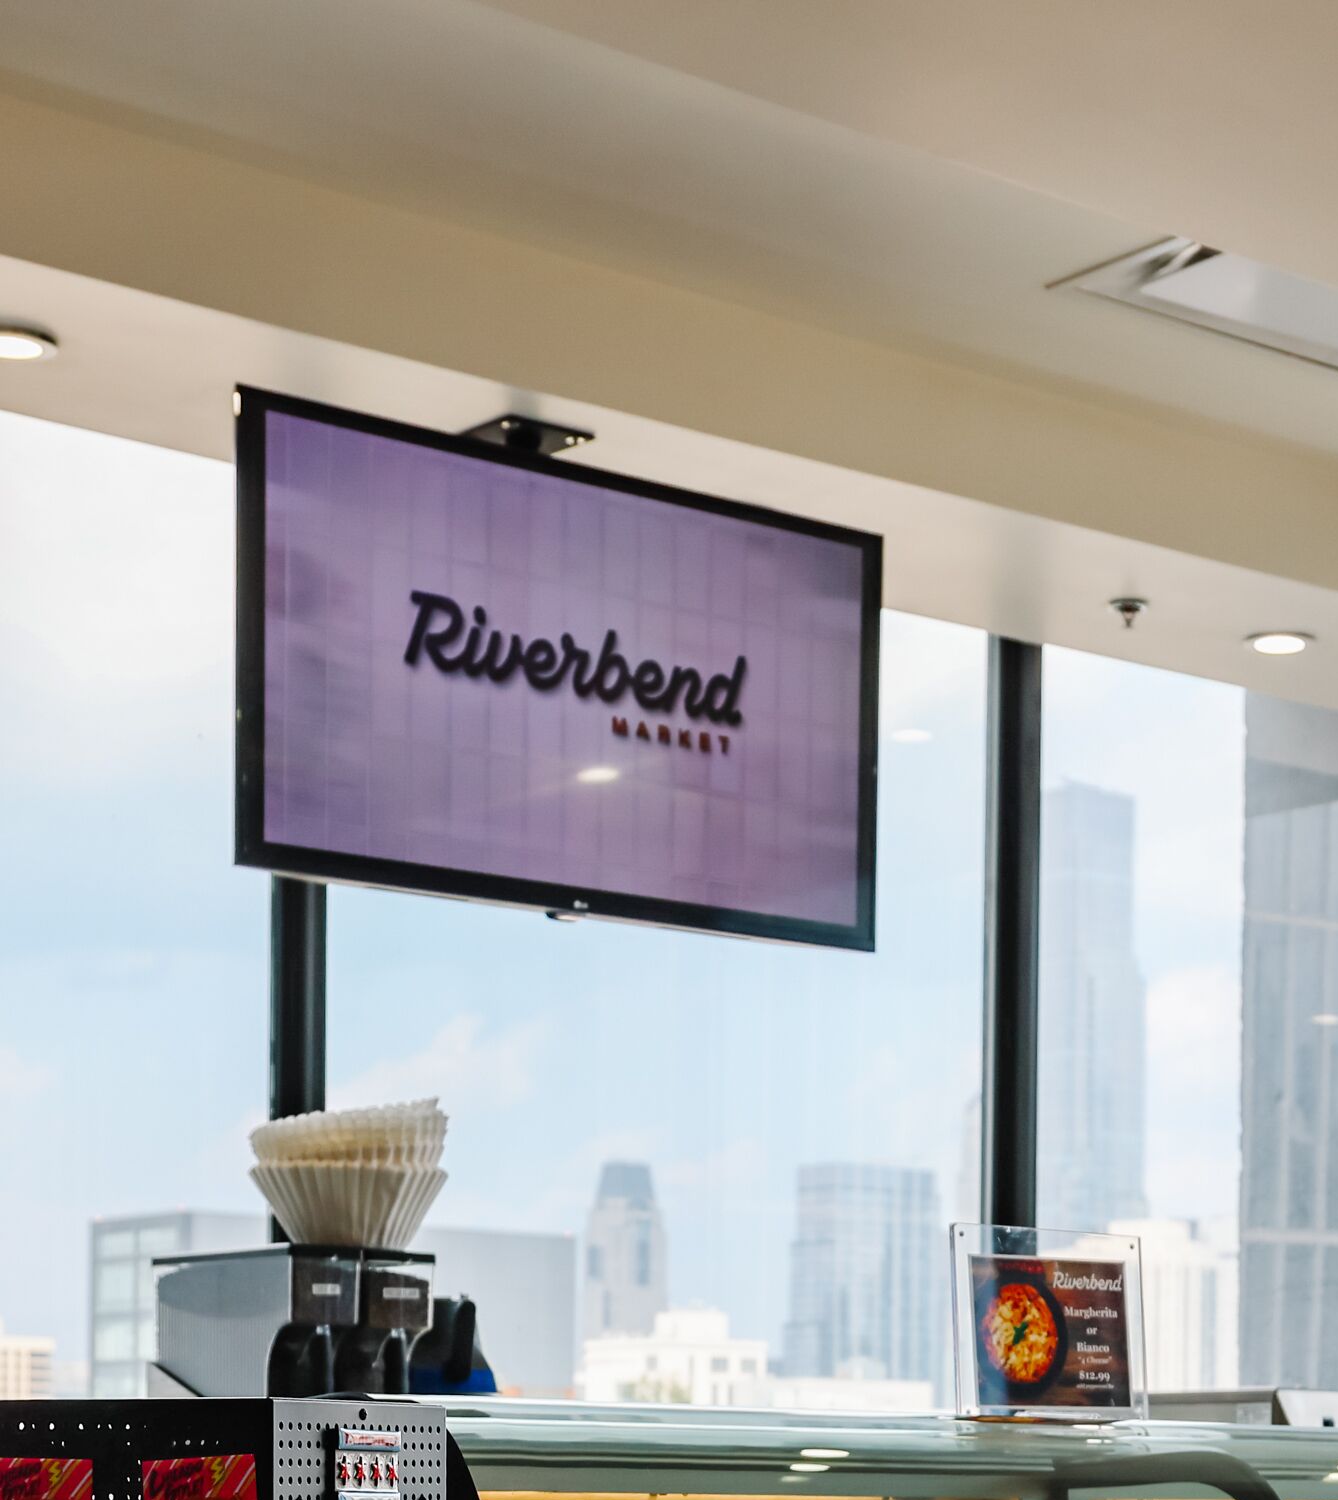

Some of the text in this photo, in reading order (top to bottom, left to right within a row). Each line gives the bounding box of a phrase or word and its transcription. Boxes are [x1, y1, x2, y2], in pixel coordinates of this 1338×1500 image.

[404, 590, 746, 726] Riverbend
[611, 716, 731, 755] MARKET
[1053, 1271, 1122, 1292] Riverbend
[1063, 1305, 1118, 1319] Margherita
[1086, 1327, 1098, 1336] or
[1076, 1341, 1110, 1353] Bianco
[1079, 1370, 1111, 1382] $12.99
